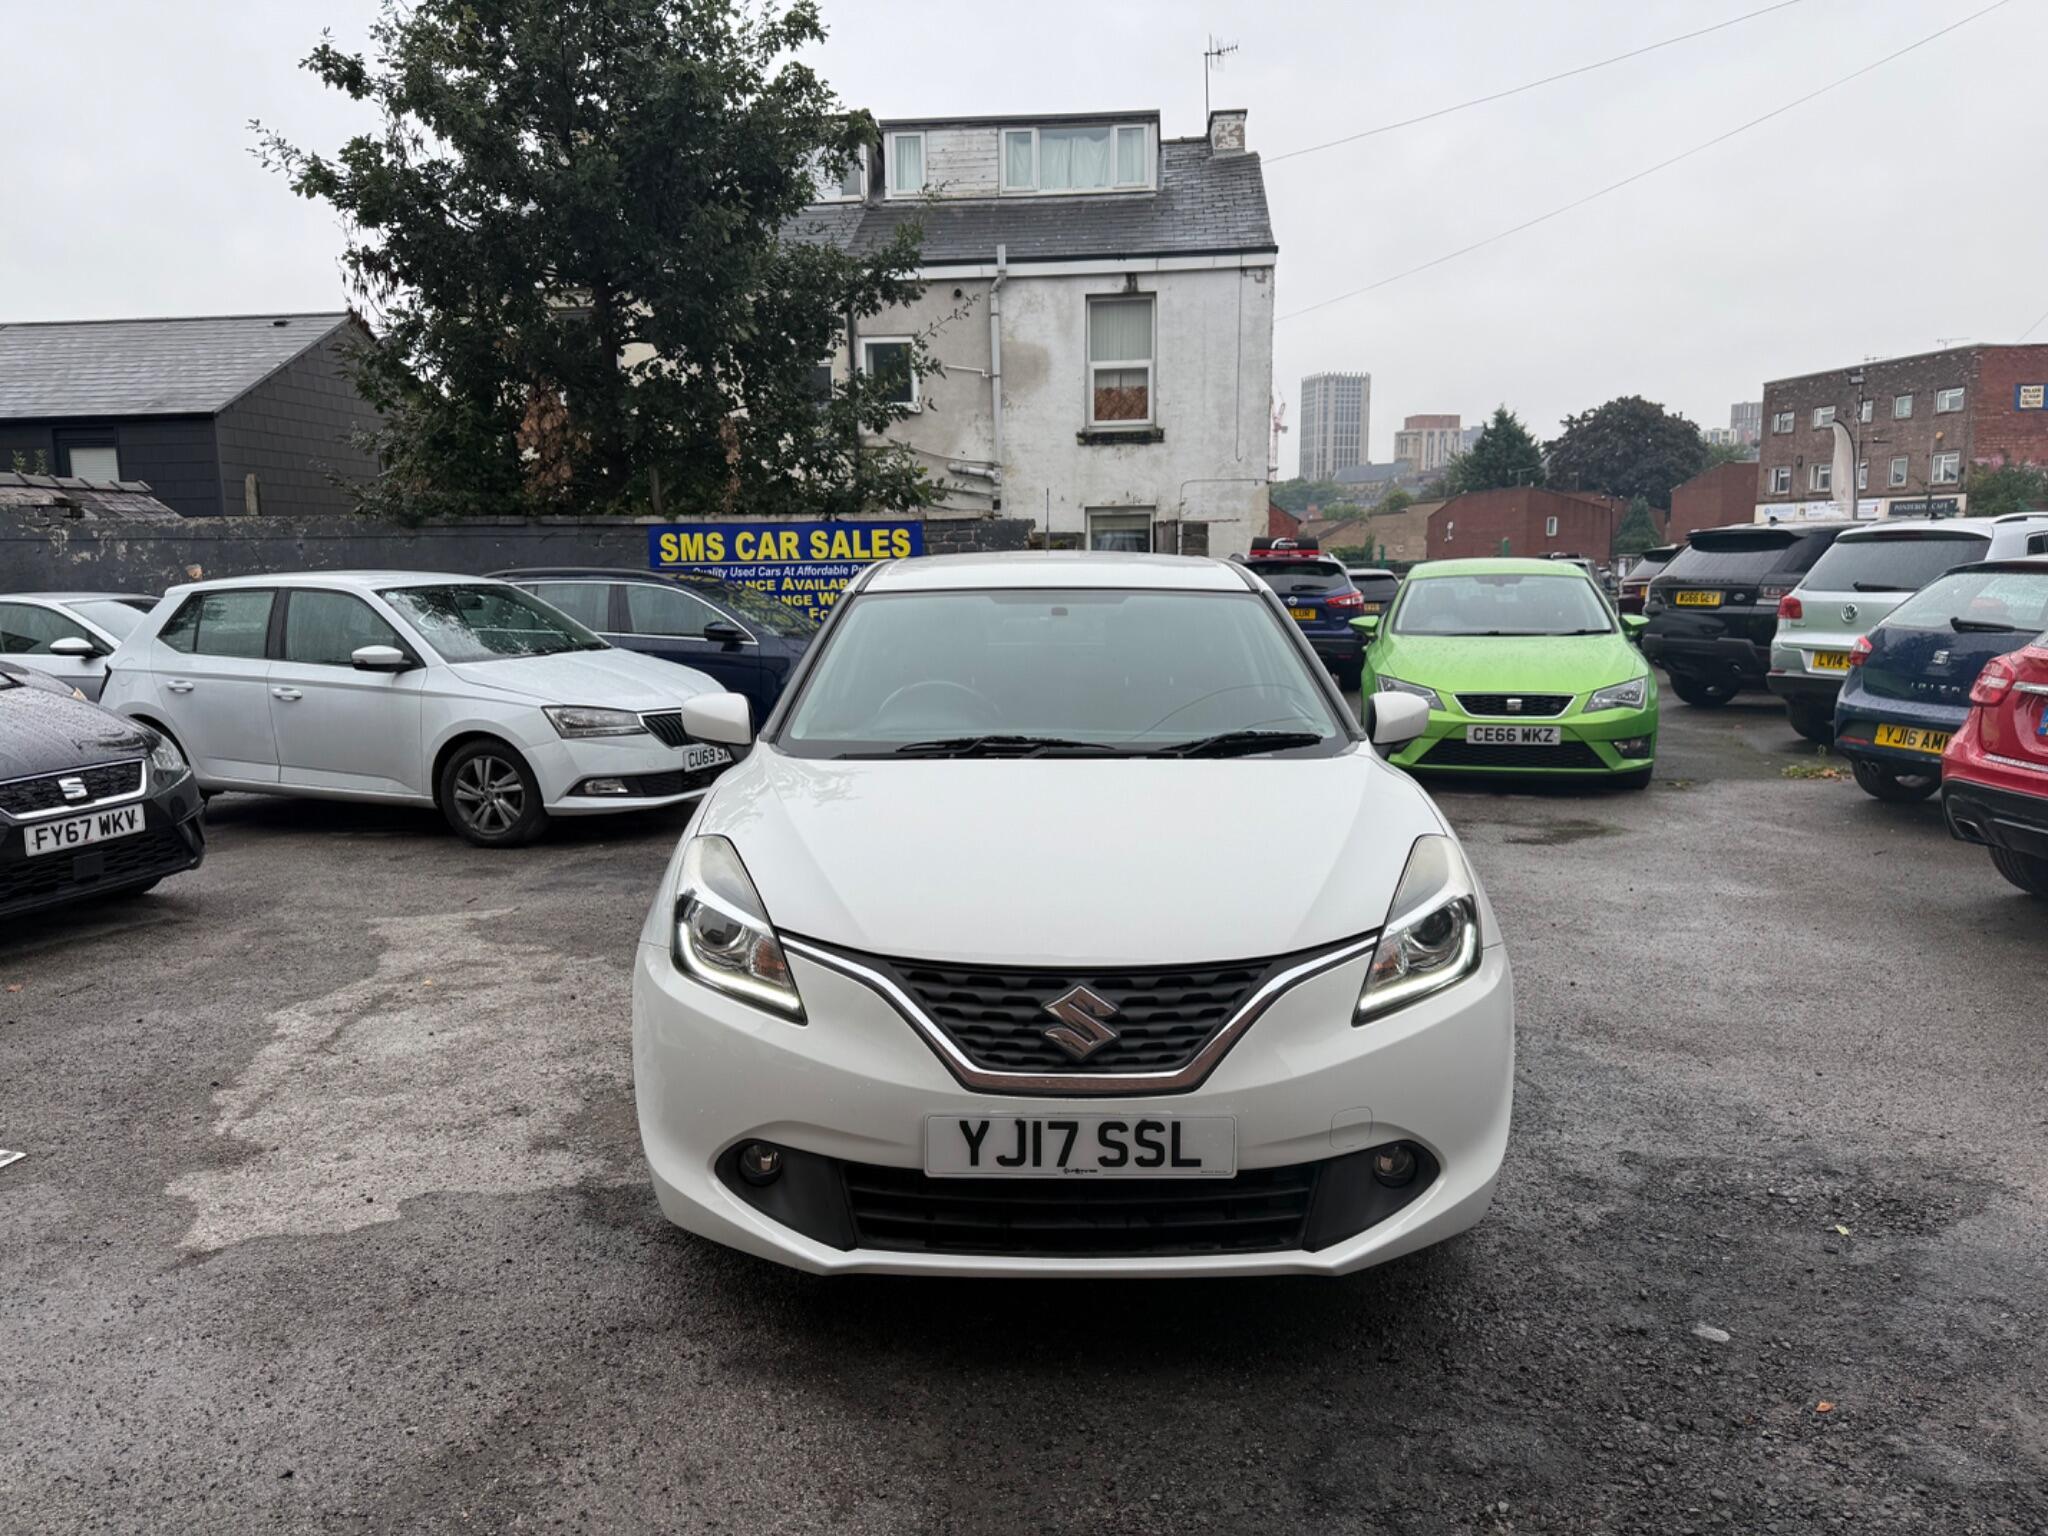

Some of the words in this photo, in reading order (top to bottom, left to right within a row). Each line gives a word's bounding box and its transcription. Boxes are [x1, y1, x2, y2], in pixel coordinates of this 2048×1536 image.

[659, 532, 725, 562] SMS
[735, 530, 801, 561] CAR
[809, 528, 912, 559] SALES
[729, 566, 756, 578] Used
[758, 566, 781, 578] Cars
[783, 565, 795, 577] At
[796, 564, 849, 576] Affordable
[1473, 727, 1516, 742] CE66
[1521, 728, 1554, 743] WKZ
[1886, 725, 1918, 746] YJ16
[689, 748, 715, 768] CU69
[35, 818, 92, 850] FY67
[98, 809, 135, 837] WKV
[959, 1119, 1079, 1168] YJ17
[1097, 1119, 1203, 1168] SSL
